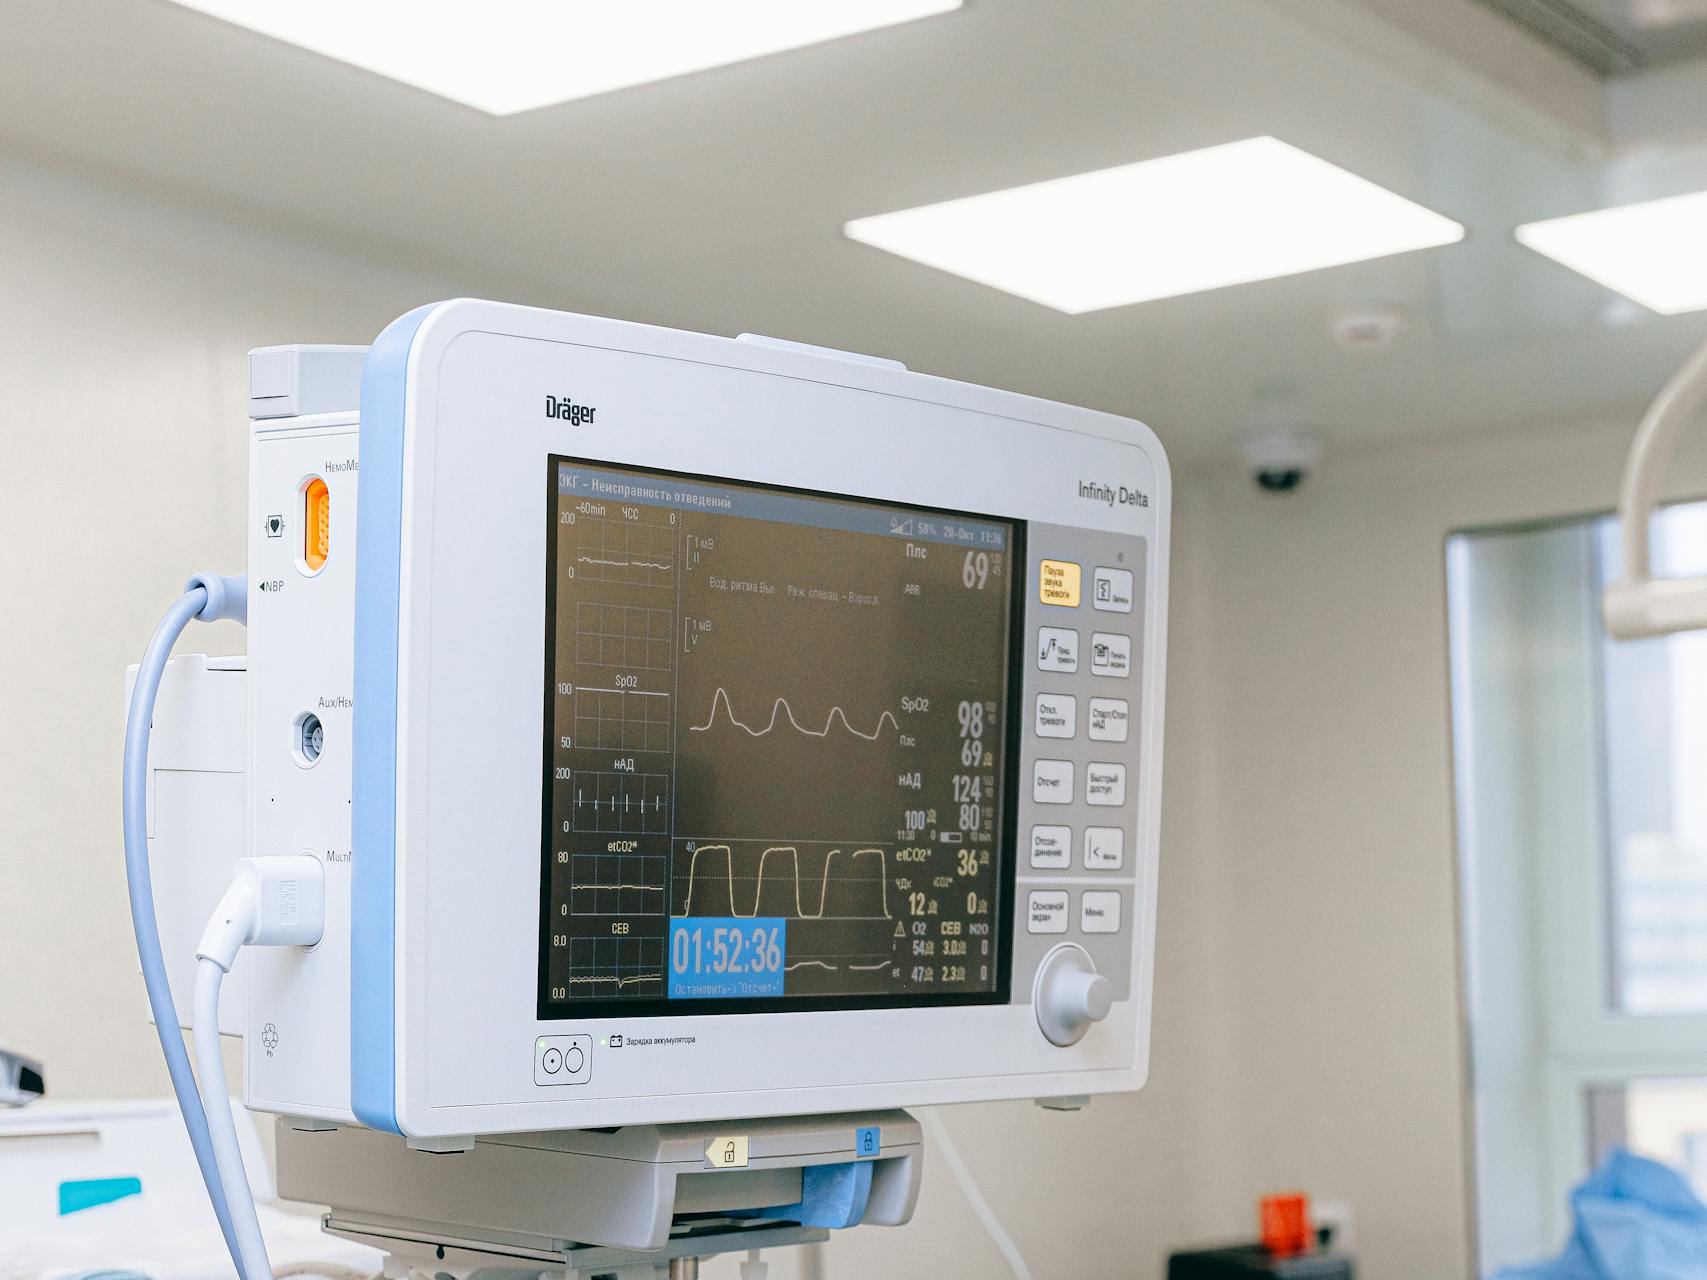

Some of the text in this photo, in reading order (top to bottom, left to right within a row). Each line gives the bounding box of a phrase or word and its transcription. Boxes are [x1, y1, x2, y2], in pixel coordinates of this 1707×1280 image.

[546, 395, 596, 426] Dräger
[559, 473, 578, 489] ЭКГ
[591, 478, 672, 502] Неисправность
[674, 492, 731, 509] отведений
[1079, 480, 1149, 507] Infinity Delta
[560, 512, 575, 524] 200
[670, 513, 675, 524] 0
[906, 543, 927, 559] Плс
[568, 567, 574, 579] 0
[962, 550, 989, 590] 69
[266, 580, 284, 592] NBP
[615, 674, 637, 688] SpO2
[558, 683, 571, 695] 100
[901, 696, 929, 713] SpO2
[958, 701, 983, 738] 98
[561, 737, 571, 749] 50
[961, 739, 982, 767] 69
[614, 758, 634, 772] нАД
[555, 768, 571, 780] 200
[899, 772, 921, 790] нАД
[952, 774, 982, 802] 124
[905, 810, 926, 830] 100
[959, 804, 980, 831] 80
[563, 820, 569, 831] 0
[557, 852, 569, 863] 80
[957, 849, 978, 876] 36
[561, 904, 567, 916] 0
[909, 892, 977, 916] 12 0
[553, 935, 567, 946] 8.0
[673, 927, 781, 974] 01:52:36
[913, 940, 924, 956] 54
[981, 940, 988, 955] 0
[911, 967, 925, 982] 47
[980, 965, 987, 981] 0
[552, 987, 566, 999] 0.0
[626, 1036, 695, 1046] Зарядка аккумулятора
[266, 1049, 274, 1058] Pb
